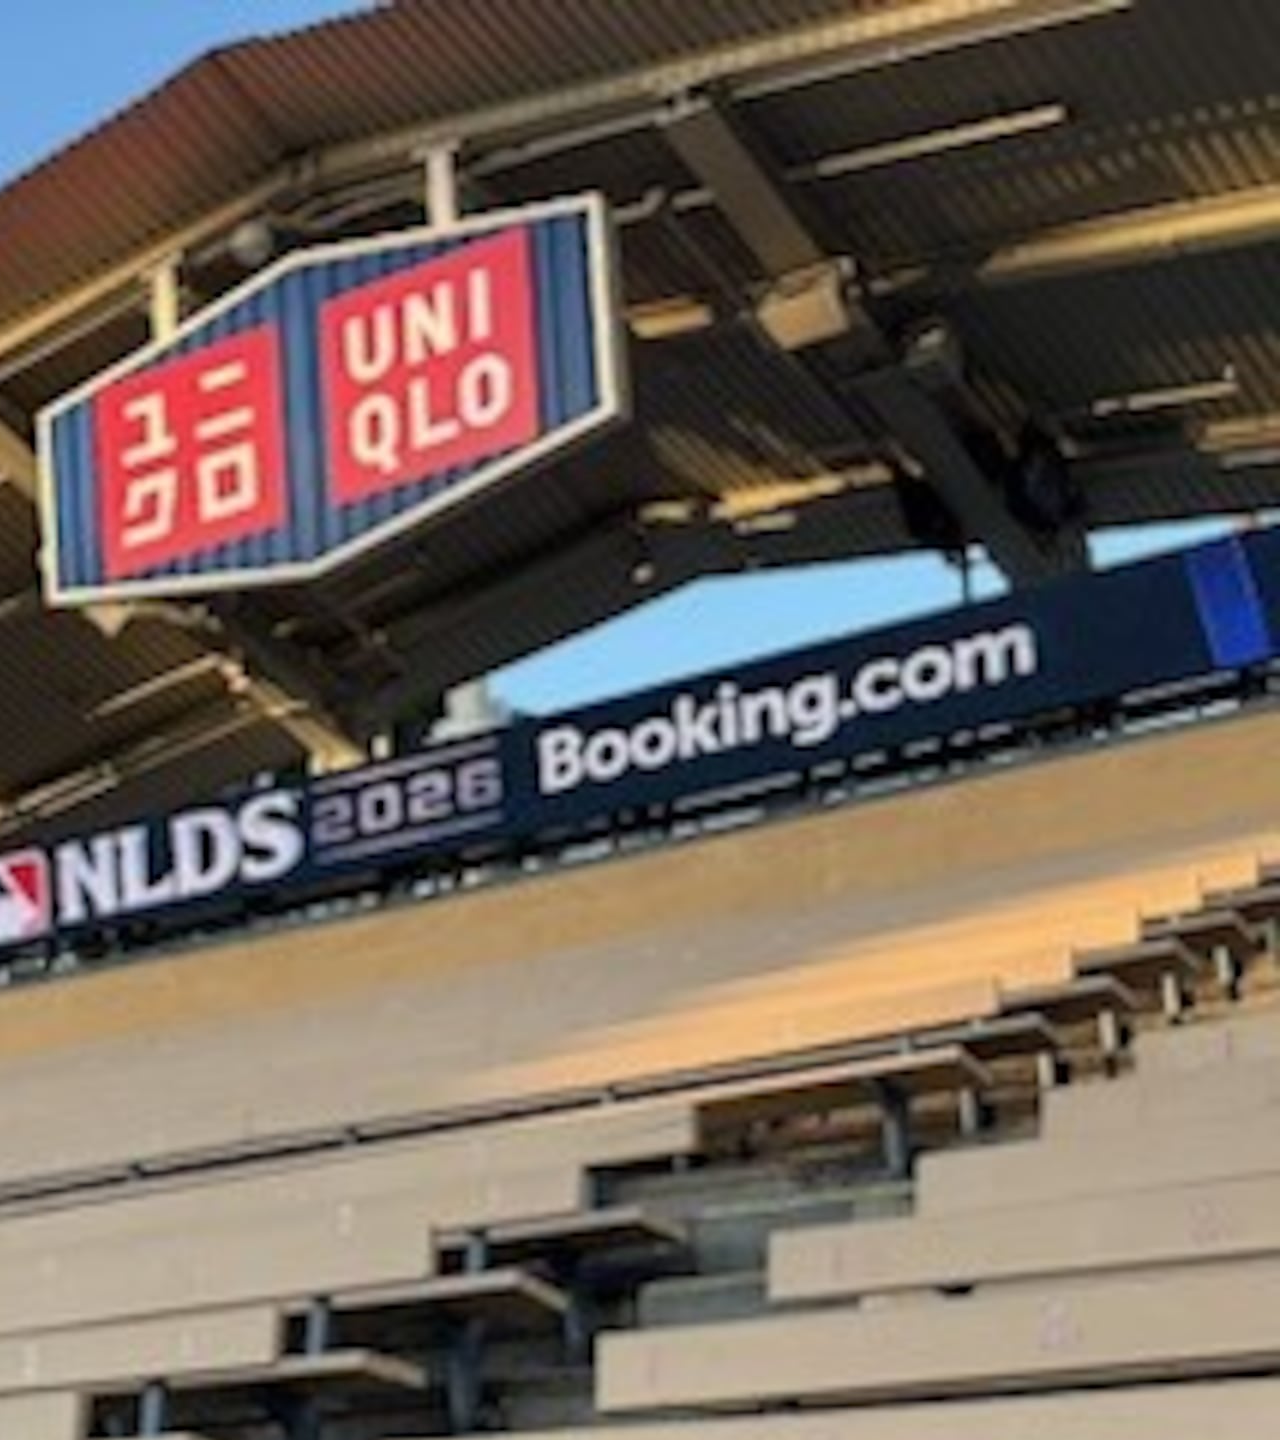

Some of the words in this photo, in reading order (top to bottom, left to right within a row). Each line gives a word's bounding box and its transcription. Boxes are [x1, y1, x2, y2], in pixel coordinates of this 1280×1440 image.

[342, 267, 490, 382] UNI
[347, 352, 512, 473] QLO
[54, 790, 304, 923] NLDS
[310, 756, 504, 845] 2026
[538, 623, 1036, 794] Booking.com
